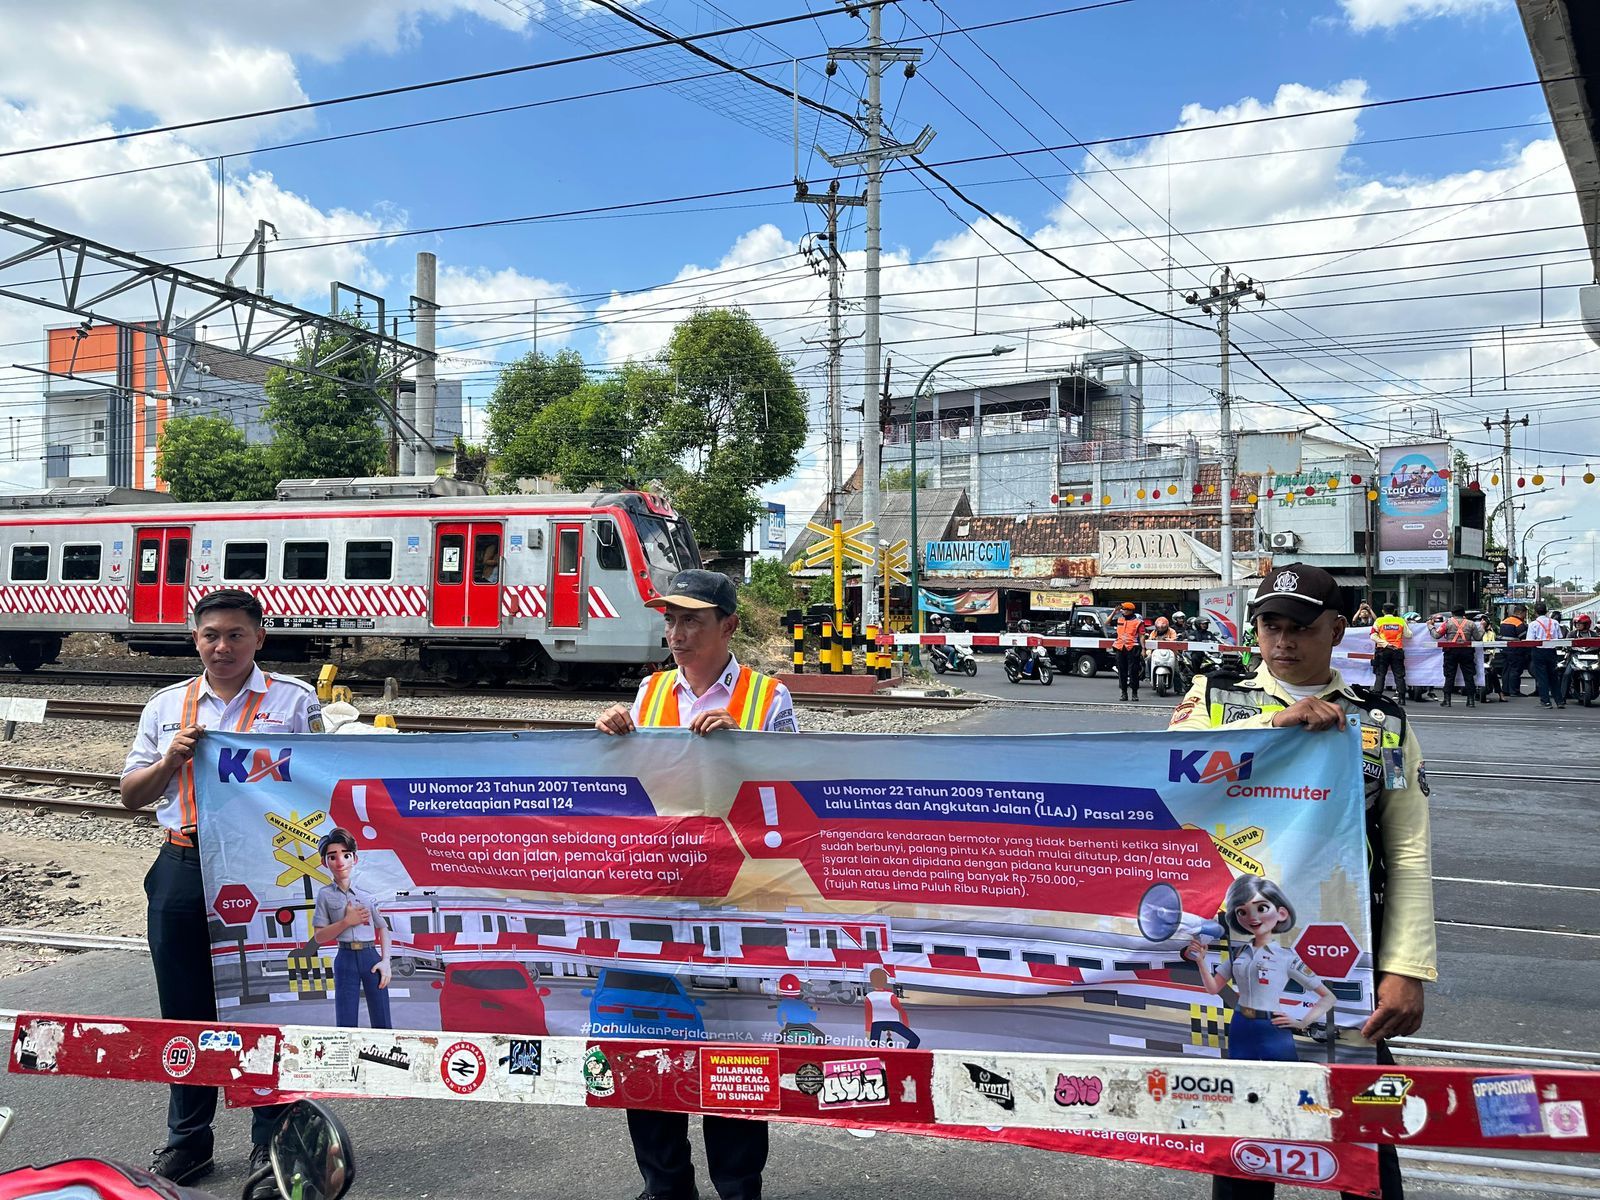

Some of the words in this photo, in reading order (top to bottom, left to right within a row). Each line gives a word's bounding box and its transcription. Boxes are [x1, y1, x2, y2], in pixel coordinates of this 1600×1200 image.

[1408, 485, 1447, 494] curious
[929, 543, 975, 562] AMANAH
[978, 543, 1007, 562] CCTV
[1103, 533, 1179, 559] PRAHA
[254, 712, 270, 720] KAI
[218, 748, 292, 782] KAI
[1168, 749, 1254, 783] KAI
[409, 782, 427, 794] UU
[430, 782, 473, 793] Nomor
[476, 781, 491, 793] 23
[493, 781, 535, 793] Tahun
[538, 781, 568, 793] 2007
[571, 781, 627, 795] Tentang
[823, 786, 841, 795] UU
[843, 786, 886, 796] Nomor
[889, 786, 904, 796] 22
[906, 786, 948, 797] Tahun
[951, 787, 983, 798] 2009
[986, 788, 1044, 803] Tentang
[1226, 784, 1331, 801] Commuter
[409, 798, 511, 812] Perkeretaapian
[513, 798, 550, 809] Pasal
[552, 798, 573, 809] 124
[825, 799, 852, 809] Lalu
[854, 799, 892, 810] Lintas
[895, 800, 920, 811] dan
[923, 802, 989, 814] Angkutan
[992, 803, 1031, 815] Jalan
[1034, 803, 1078, 820] (LLAJ)
[1084, 808, 1124, 821] Pasal
[1128, 809, 1154, 821] 296
[270, 817, 288, 829] AWAS
[287, 826, 311, 841] KERETA
[304, 813, 323, 828] SEPUR
[421, 832, 455, 844] Pada
[459, 833, 548, 847] perpotongan
[552, 832, 616, 848] sebidang
[620, 833, 667, 846] antara
[670, 832, 704, 848] jalur
[820, 830, 884, 841] Pengendara
[886, 831, 946, 842] kendaraan
[949, 833, 1000, 844] bermotor
[1003, 837, 1033, 848] yang
[1035, 836, 1066, 847] tidak
[1068, 838, 1118, 849] berhenti
[1121, 840, 1159, 850] ketika
[1162, 840, 1199, 854] sinyal
[1233, 830, 1259, 846] SEPUR
[427, 847, 465, 860] kereta
[468, 849, 490, 863] api
[493, 849, 519, 861] dan
[522, 849, 561, 864] jalan,
[565, 850, 626, 865] pemakai
[628, 850, 664, 865] jalan
[668, 851, 707, 867] wajib
[821, 842, 854, 851] sudah
[856, 843, 906, 854] berbunyi,
[908, 844, 948, 856] palang
[950, 846, 979, 858] pintu
[981, 847, 996, 856] KA
[999, 848, 1035, 859] sudah
[1038, 849, 1071, 860] mulai
[1073, 850, 1121, 863] ditutup,
[1124, 850, 1183, 866] dan/atau
[1186, 857, 1211, 868] ada
[431, 861, 527, 877] mendahulukan
[531, 867, 605, 882] perjalanan
[609, 868, 653, 880] kereta
[656, 869, 684, 884] api.
[822, 854, 858, 866] isyarat
[860, 855, 880, 865] lain
[882, 856, 910, 866] akan
[912, 857, 962, 868] dipidana
[964, 859, 1008, 871] dengan
[1010, 860, 1052, 873] pidana
[1054, 862, 1112, 876] kurungan
[1115, 865, 1153, 881] paling
[1156, 868, 1189, 881] lama
[1243, 861, 1259, 873] API
[823, 867, 830, 876] 3
[832, 867, 862, 877] bulan
[864, 868, 889, 878] atau
[892, 869, 927, 879] denda
[929, 870, 965, 882] paling
[967, 872, 1009, 884] banyak
[1012, 873, 1085, 888] Rp.750.000,-
[824, 879, 858, 890] (Tujuh
[860, 880, 891, 890] Ratus
[892, 881, 919, 891] Lima
[921, 882, 951, 892] Puluh
[954, 884, 979, 893] Ribu
[981, 886, 1029, 898] Rupiah).
[222, 899, 252, 909] STOP
[1307, 945, 1350, 957] STOP
[580, 1022, 754, 1042] #DahulukanPerjalananKA
[761, 1031, 905, 1049] #DisiplinPerlintasan
[170, 1049, 189, 1065] 99
[710, 1056, 769, 1065] WARNING!!!
[833, 1062, 868, 1072] HELLO
[457, 1082, 478, 1092] TOUR
[710, 1075, 742, 1083] BUANG
[744, 1076, 770, 1084] KACA
[710, 1083, 734, 1091] ATAU
[736, 1084, 770, 1092] BELING
[1172, 1075, 1234, 1094] JOGJA
[1472, 1079, 1536, 1097] OPPOSITION
[717, 1092, 726, 1100] DI
[728, 1093, 764, 1101] SUNGAI
[1171, 1092, 1199, 1100] sewa
[1202, 1093, 1234, 1103] motor
[1272, 1147, 1320, 1177] 121
